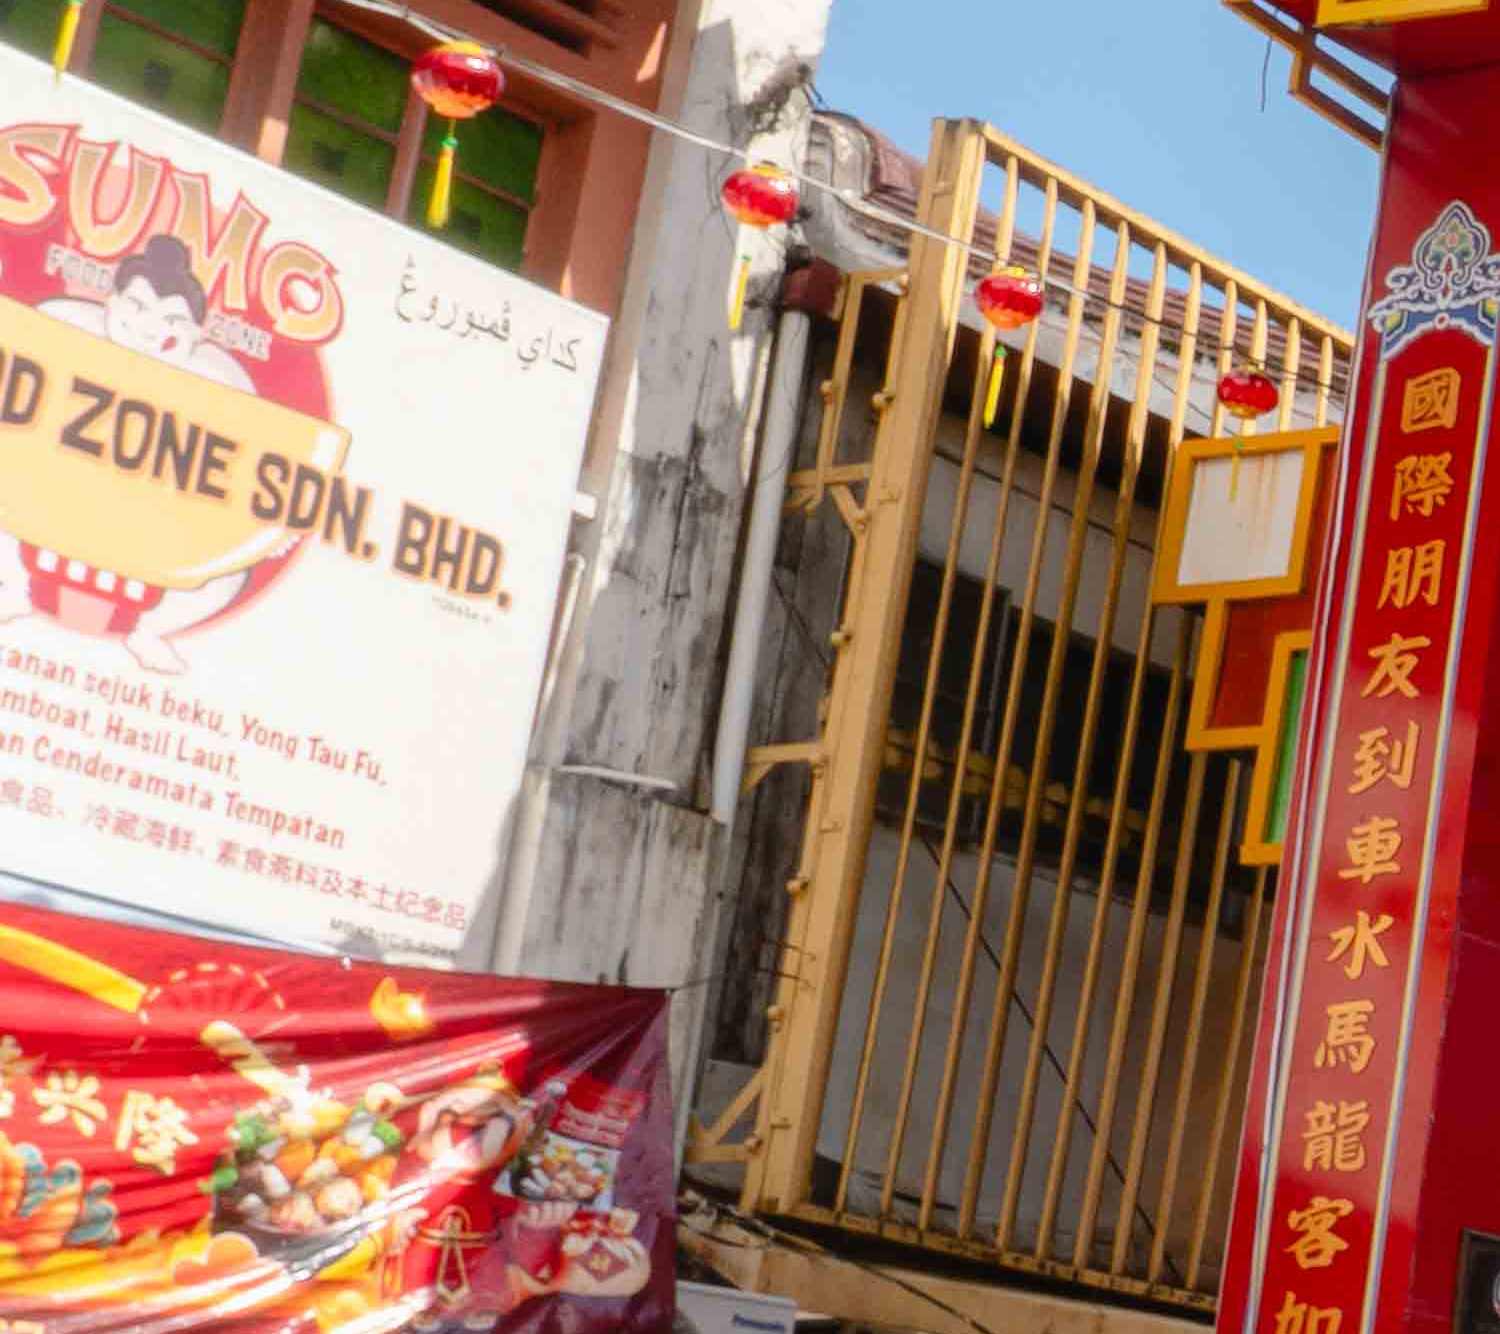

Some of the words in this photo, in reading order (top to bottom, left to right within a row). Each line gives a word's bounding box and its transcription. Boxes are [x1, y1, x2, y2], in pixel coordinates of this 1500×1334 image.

[0, 123, 345, 345] SUMO
[60, 376, 238, 501] ZONE
[250, 450, 379, 560] SDN.
[393, 500, 512, 609] BHD.
[84, 671, 153, 712] sejuk
[240, 714, 299, 761] Yong
[306, 737, 349, 773] Tau
[353, 748, 390, 788] Fu,
[104, 714, 172, 757] Hasil
[32, 734, 215, 813] Cenderamata
[224, 790, 346, 851] Tempatan
